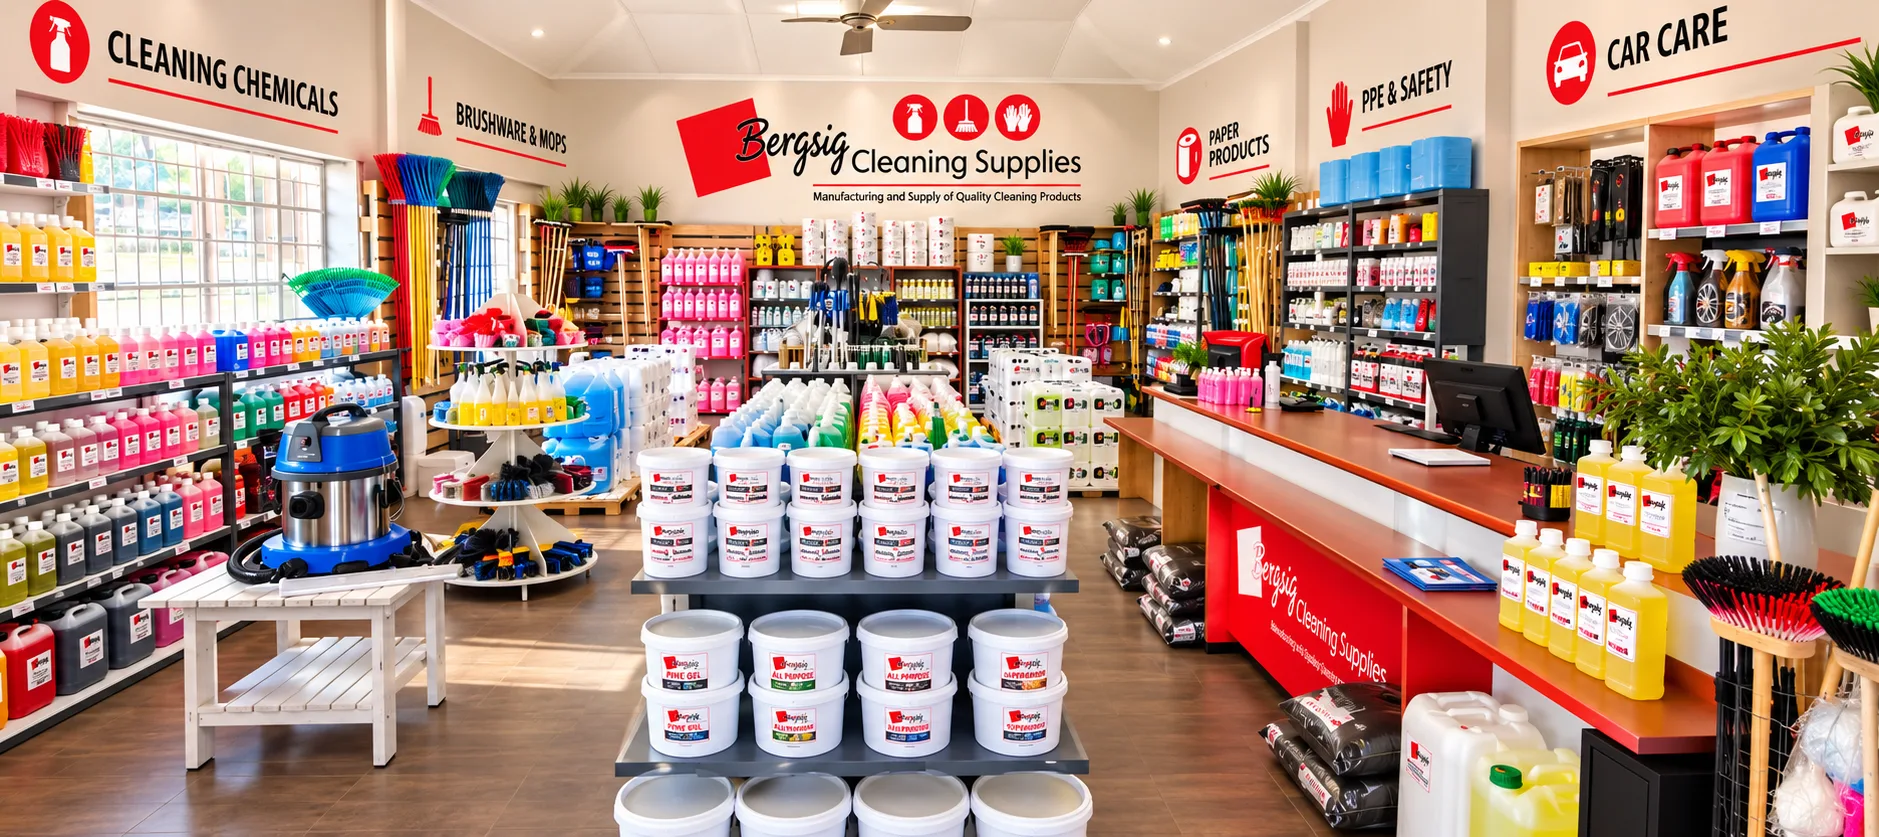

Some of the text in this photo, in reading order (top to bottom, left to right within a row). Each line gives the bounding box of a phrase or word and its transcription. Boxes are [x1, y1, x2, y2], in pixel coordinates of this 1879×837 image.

[1607, 5, 1729, 71] CAR CARE
[107, 30, 339, 117] CLEANING CHEMICALS
[1362, 60, 1453, 114] PPE & SAFETY
[456, 101, 567, 154] BRUSHWARE & MOPS
[735, 117, 850, 177] Bergsig
[1209, 121, 1240, 147] PAPER
[1209, 134, 1270, 168] PRODUCTS
[851, 148, 1082, 180] Cleaning Supplies
[813, 191, 1082, 203] Manufacturing and Supply of Quality Cleaning Products
[1251, 540, 1298, 617] Bergsig
[1296, 599, 1338, 657] Cleaning
[1339, 631, 1387, 683] Supplies
